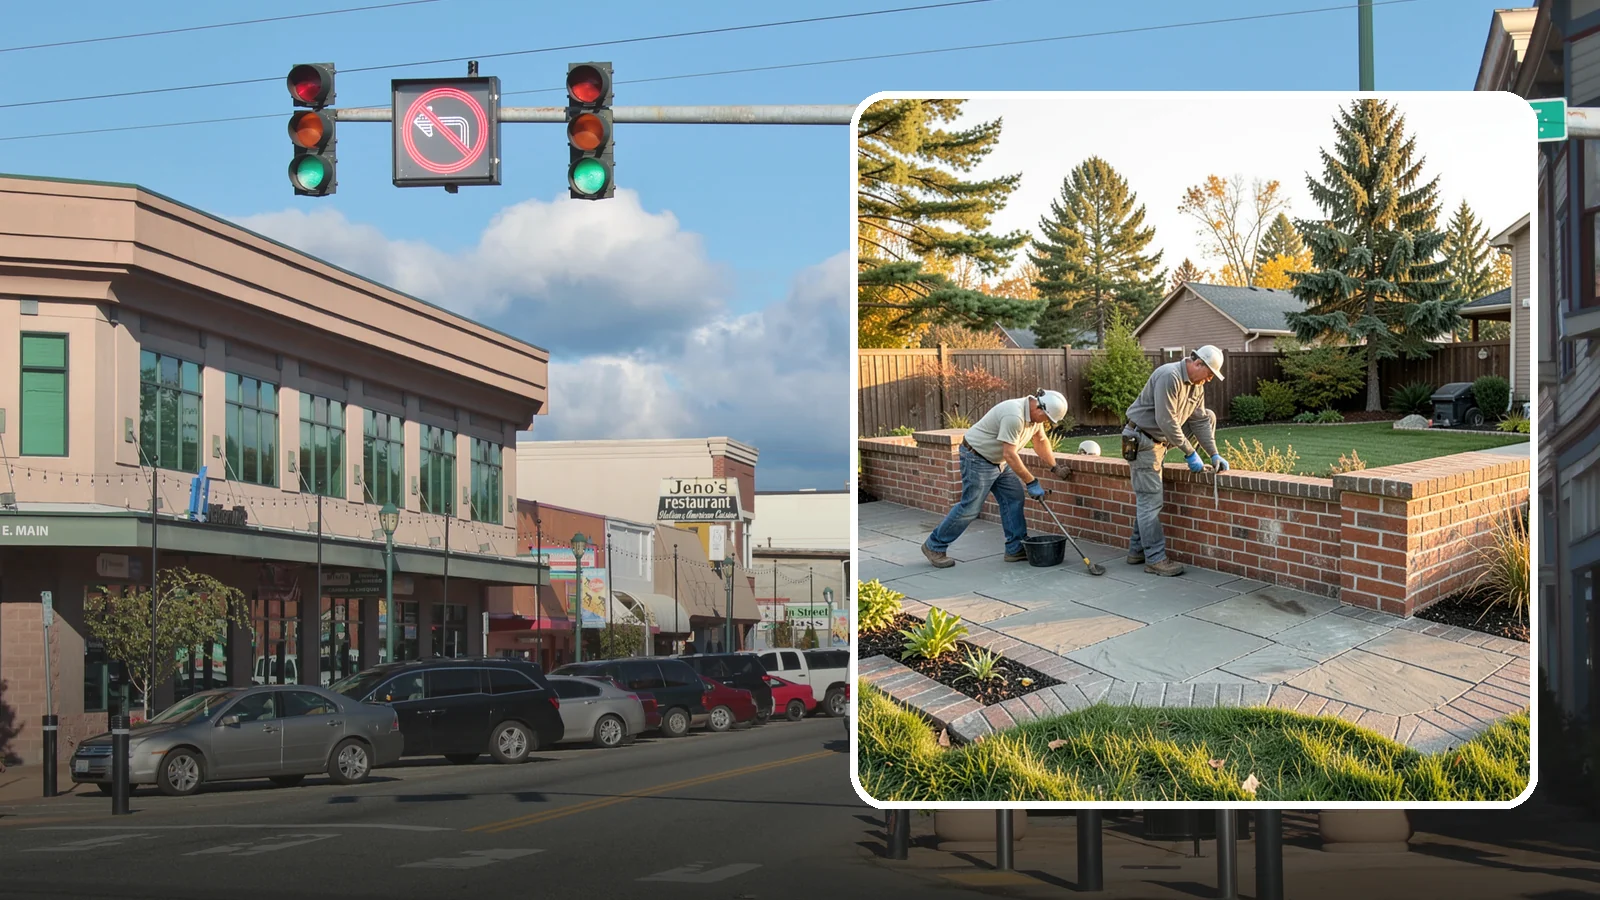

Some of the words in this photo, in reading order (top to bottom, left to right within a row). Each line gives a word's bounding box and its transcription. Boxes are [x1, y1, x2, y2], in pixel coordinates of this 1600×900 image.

[669, 479, 727, 495] Jeno's
[665, 496, 731, 509] restaurant
[658, 510, 682, 520] Italian
[686, 509, 715, 519] American
[715, 509, 738, 519] Cuisine
[2, 525, 13, 536] E.
[15, 525, 49, 536] MAIN
[797, 607, 829, 617] Street
[790, 619, 824, 627] lass
